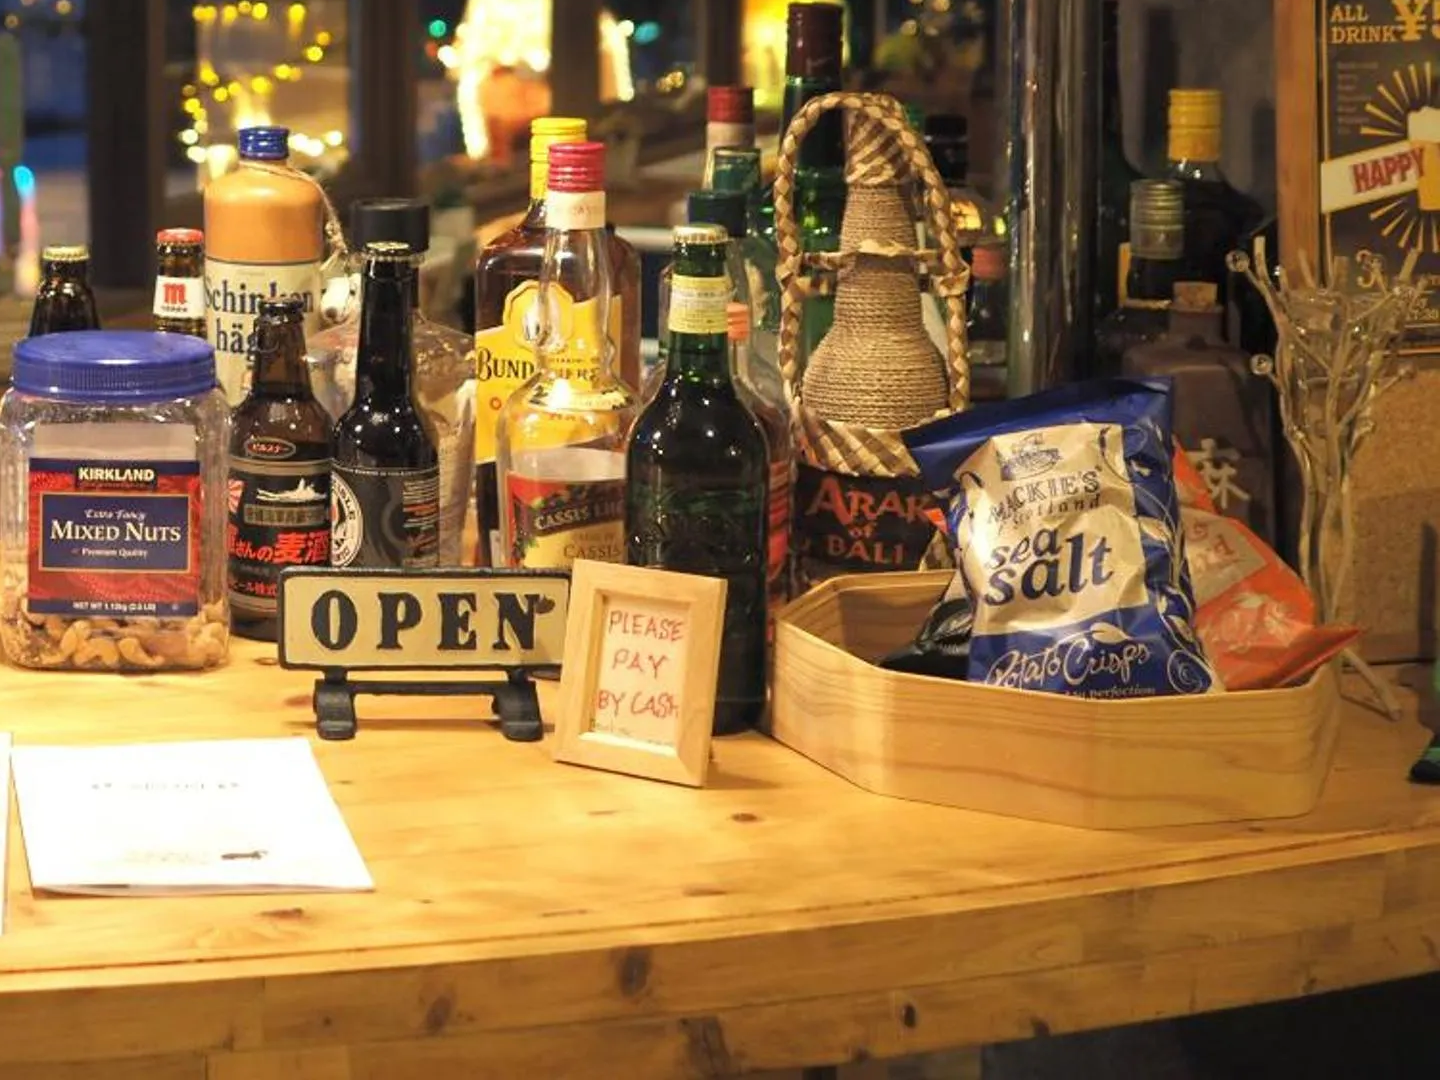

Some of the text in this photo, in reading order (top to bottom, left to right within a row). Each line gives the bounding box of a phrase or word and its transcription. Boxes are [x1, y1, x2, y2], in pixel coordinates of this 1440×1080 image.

[1330, 3, 1370, 23] ALL
[1330, 25, 1398, 45] DRINK
[1353, 147, 1425, 194] HAPPY
[203, 276, 315, 315] Schinn
[78, 466, 156, 482] KIRKLAND
[804, 476, 930, 526] ARAK
[534, 506, 590, 530] CASSIS
[118, 547, 148, 560] Quality
[563, 544, 622, 561] CASSIS
[826, 533, 905, 565] BALI
[985, 527, 1063, 570] sea
[984, 531, 1113, 607] salt
[310, 589, 551, 652] OPEN
[608, 609, 685, 641] PLEASE
[611, 652, 670, 679] PAY
[1062, 637, 1153, 686] Crisps
[597, 689, 625, 716] BY
